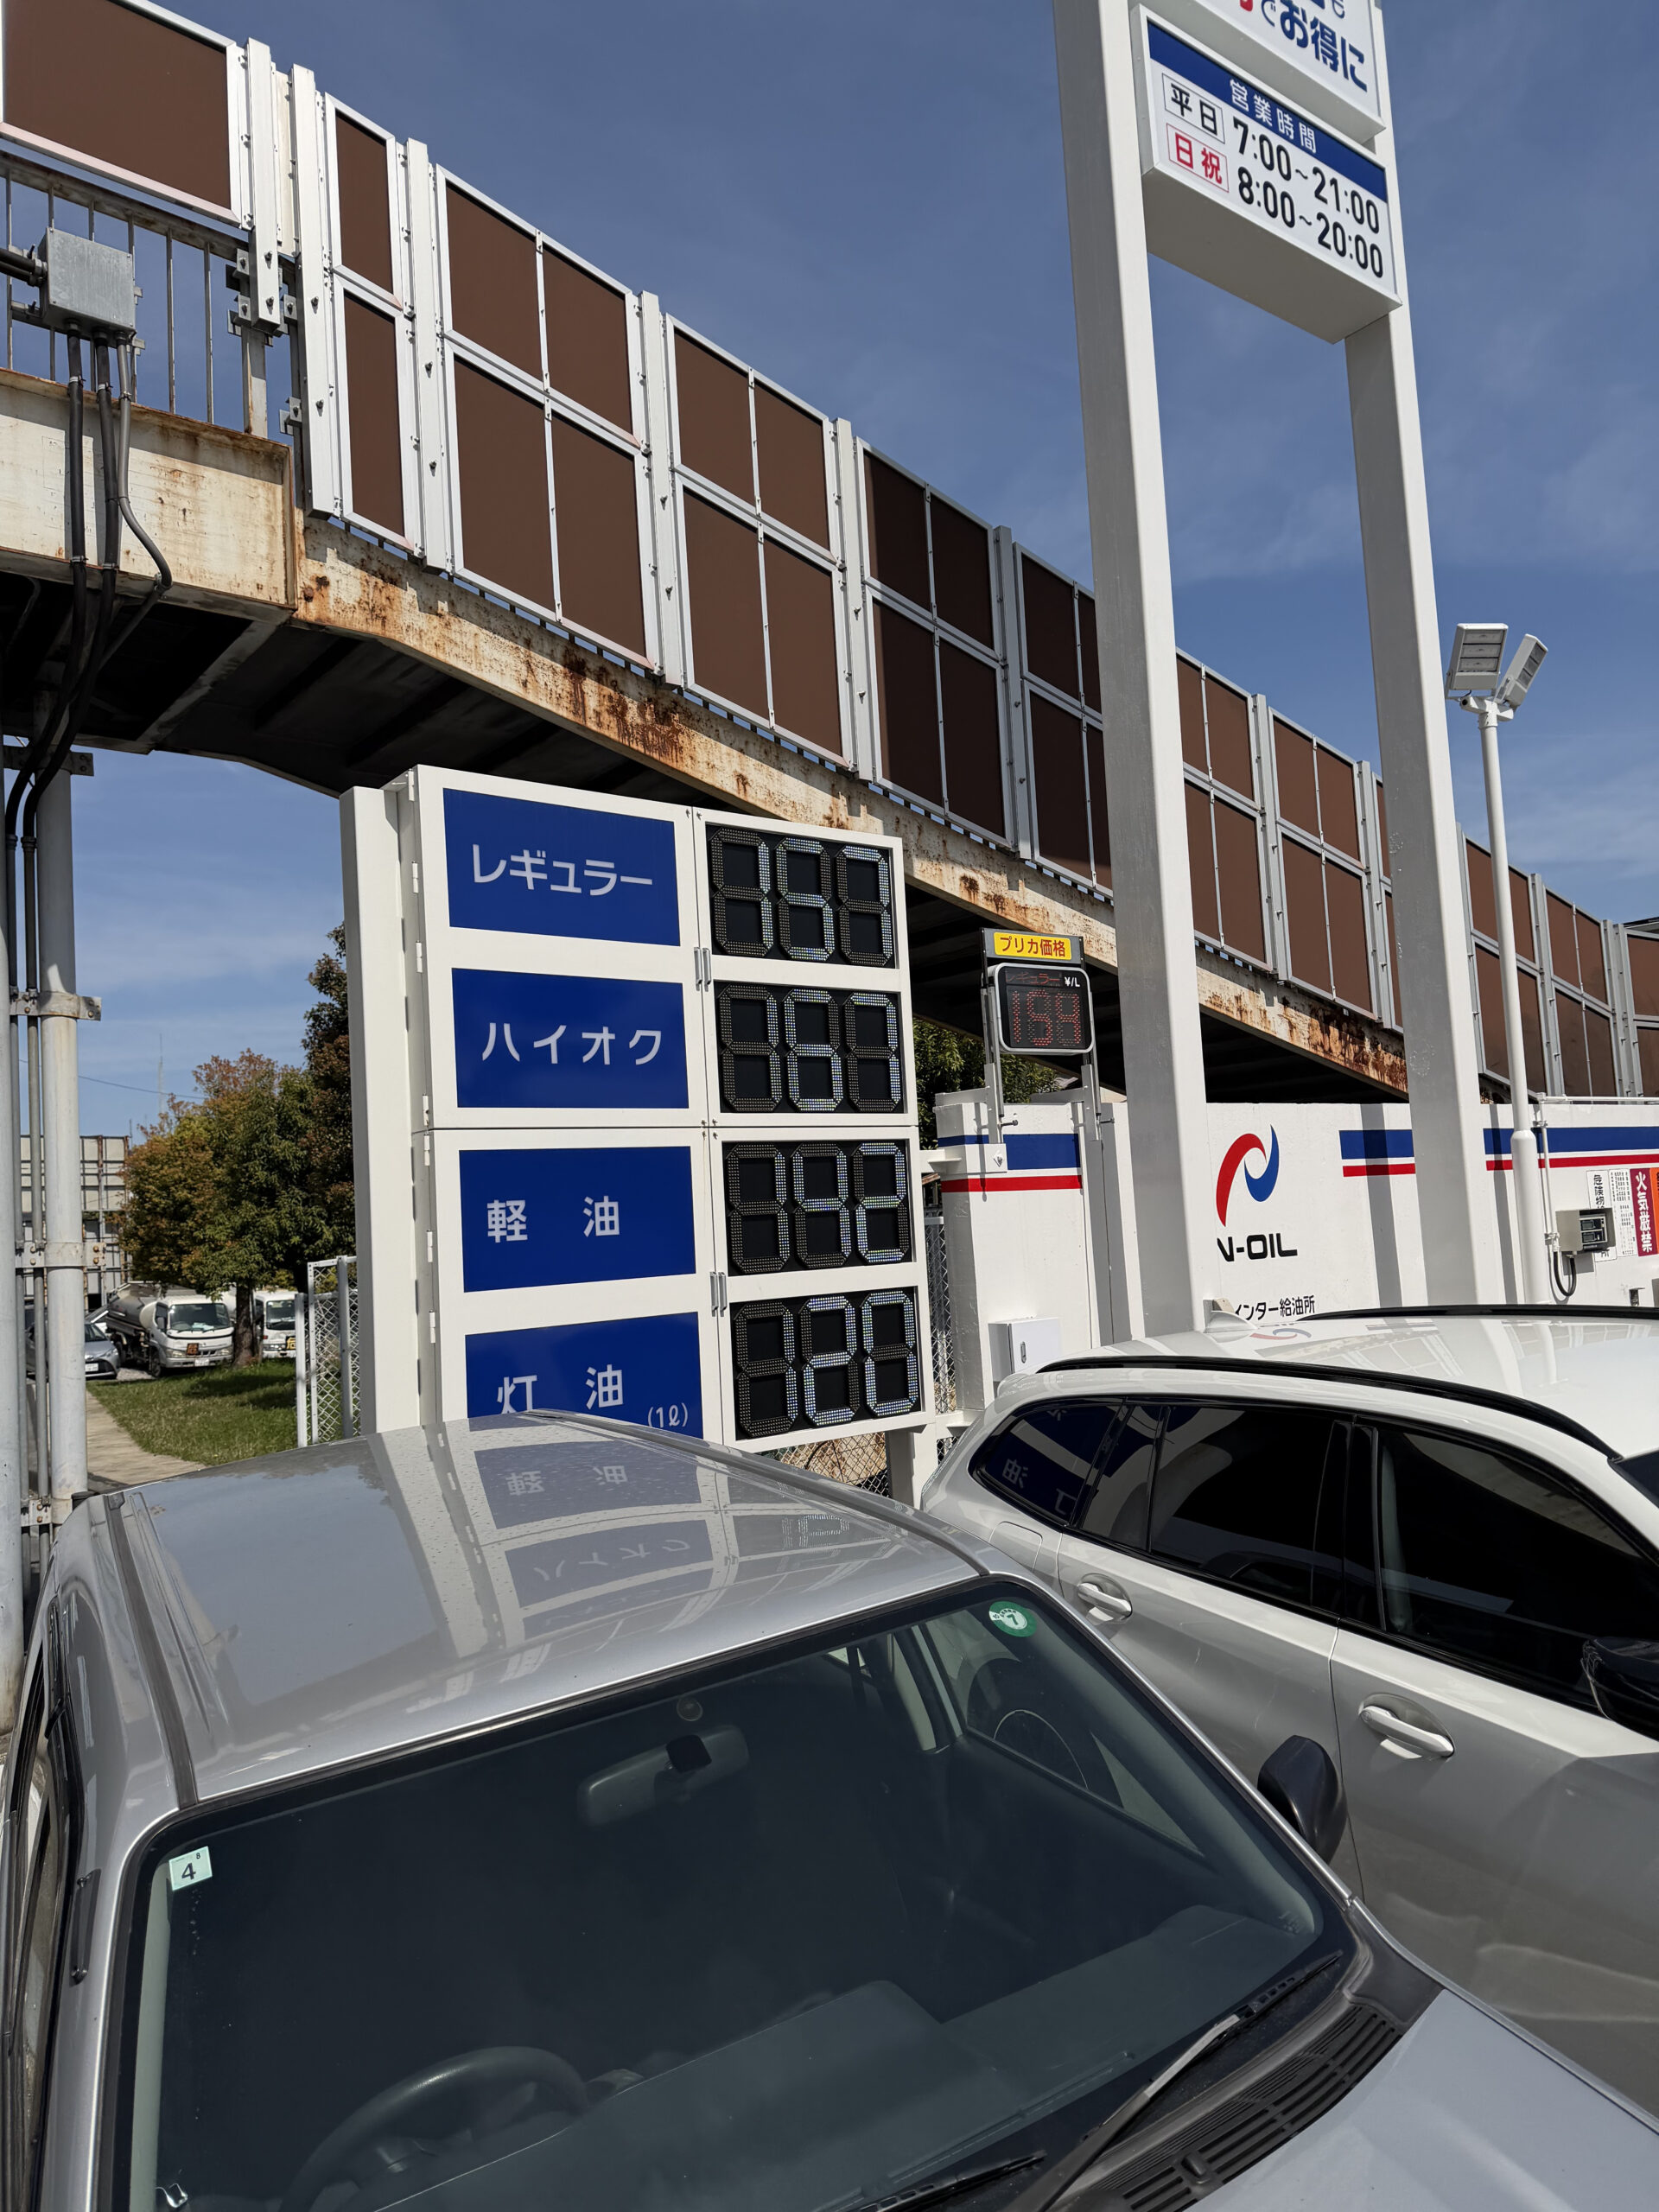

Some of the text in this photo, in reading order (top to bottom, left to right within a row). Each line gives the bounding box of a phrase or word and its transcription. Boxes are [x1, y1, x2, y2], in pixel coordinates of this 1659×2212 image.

[1171, 83, 1217, 136] 平日
[1230, 79, 1316, 153] 営業時間
[1175, 132, 1223, 184] 日祝
[473, 843, 653, 896] レギュラー
[755, 836, 892, 963] 157
[1000, 936, 1066, 957] プリカ価格
[482, 1023, 662, 1065] ハイオク
[764, 988, 901, 1113] 167
[772, 1142, 906, 1270] 142
[1636, 1172, 1652, 1253] 火気厳禁
[780, 1292, 918, 1427] 120
[181, 1862, 196, 1880] 4
